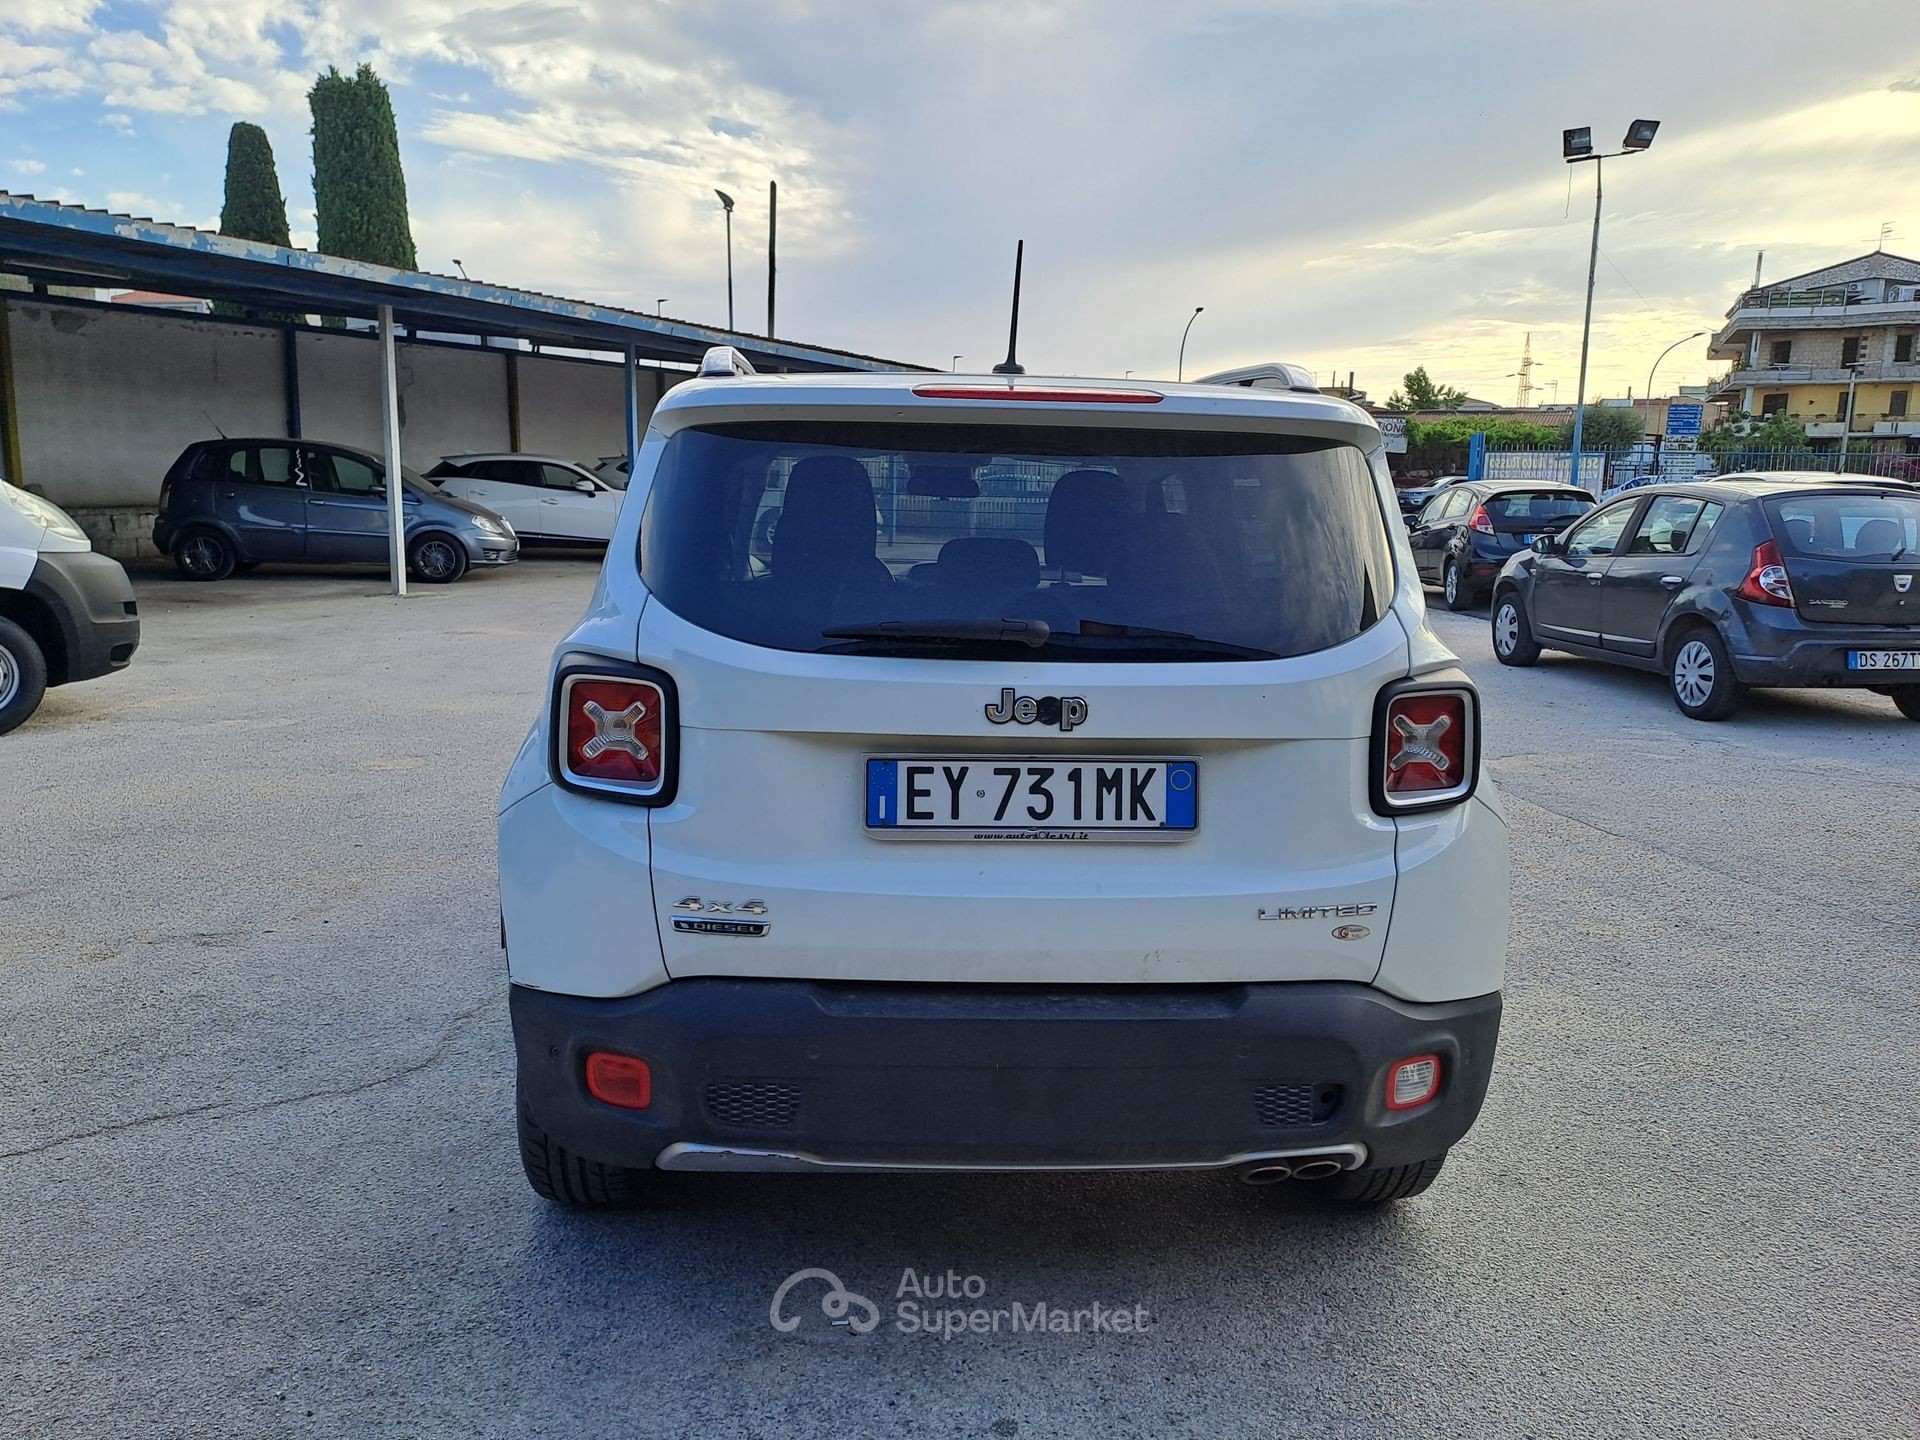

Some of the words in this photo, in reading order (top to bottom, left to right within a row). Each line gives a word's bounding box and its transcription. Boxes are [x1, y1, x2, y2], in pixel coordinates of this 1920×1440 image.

[1860, 653, 1877, 667] DS
[985, 688, 1089, 731] Jep
[906, 766, 969, 820] EY
[993, 767, 1157, 821] 731MK
[1258, 902, 1377, 920] LIMITED
[693, 922, 761, 933] DIESEL
